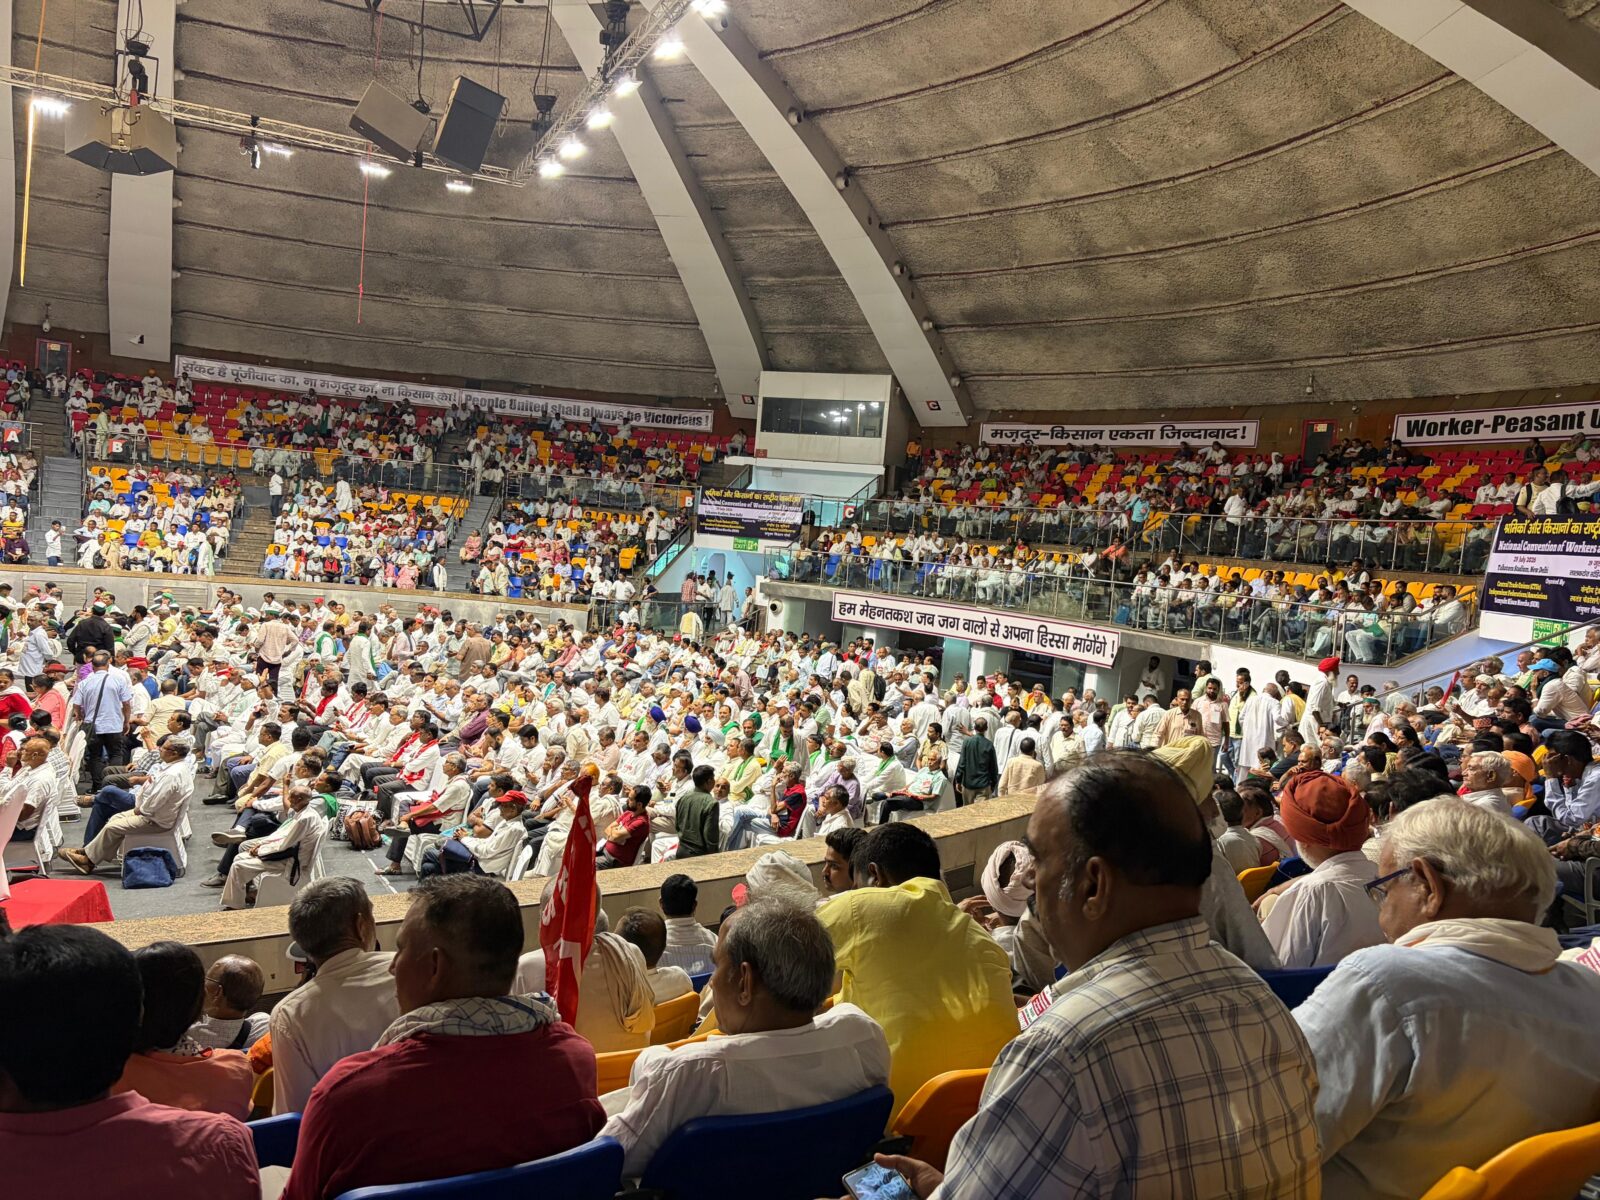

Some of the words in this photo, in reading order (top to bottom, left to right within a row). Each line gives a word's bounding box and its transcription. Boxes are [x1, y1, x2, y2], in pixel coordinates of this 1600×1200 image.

[182, 361, 215, 375] संकट
[217, 364, 228, 377] है
[465, 394, 507, 410] People
[509, 398, 548, 413] United
[551, 403, 580, 417] shall
[583, 406, 624, 421] always
[644, 411, 702, 426] Victorious
[1406, 410, 1586, 437] Worker-Peasant
[6, 431, 19, 443] A
[1109, 429, 1155, 440] एकता
[1160, 425, 1246, 440] जिन्दाबाद!
[112, 441, 123, 452] B
[685, 496, 694, 507] B
[845, 507, 855, 519] C
[1527, 518, 1542, 534] और
[1542, 518, 1573, 534] किसानों
[1570, 523, 1583, 534] का
[1498, 539, 1524, 551] National
[1524, 540, 1557, 552] Convention
[1557, 540, 1567, 552] of
[1566, 540, 1596, 553] Workers
[839, 602, 857, 615] हम
[860, 600, 914, 623] मेहनतकश
[916, 611, 935, 627] जब
[938, 615, 960, 630] जग
[990, 618, 1000, 637] से
[1002, 625, 1034, 643] अपना
[1037, 625, 1070, 649] हिस्सा
